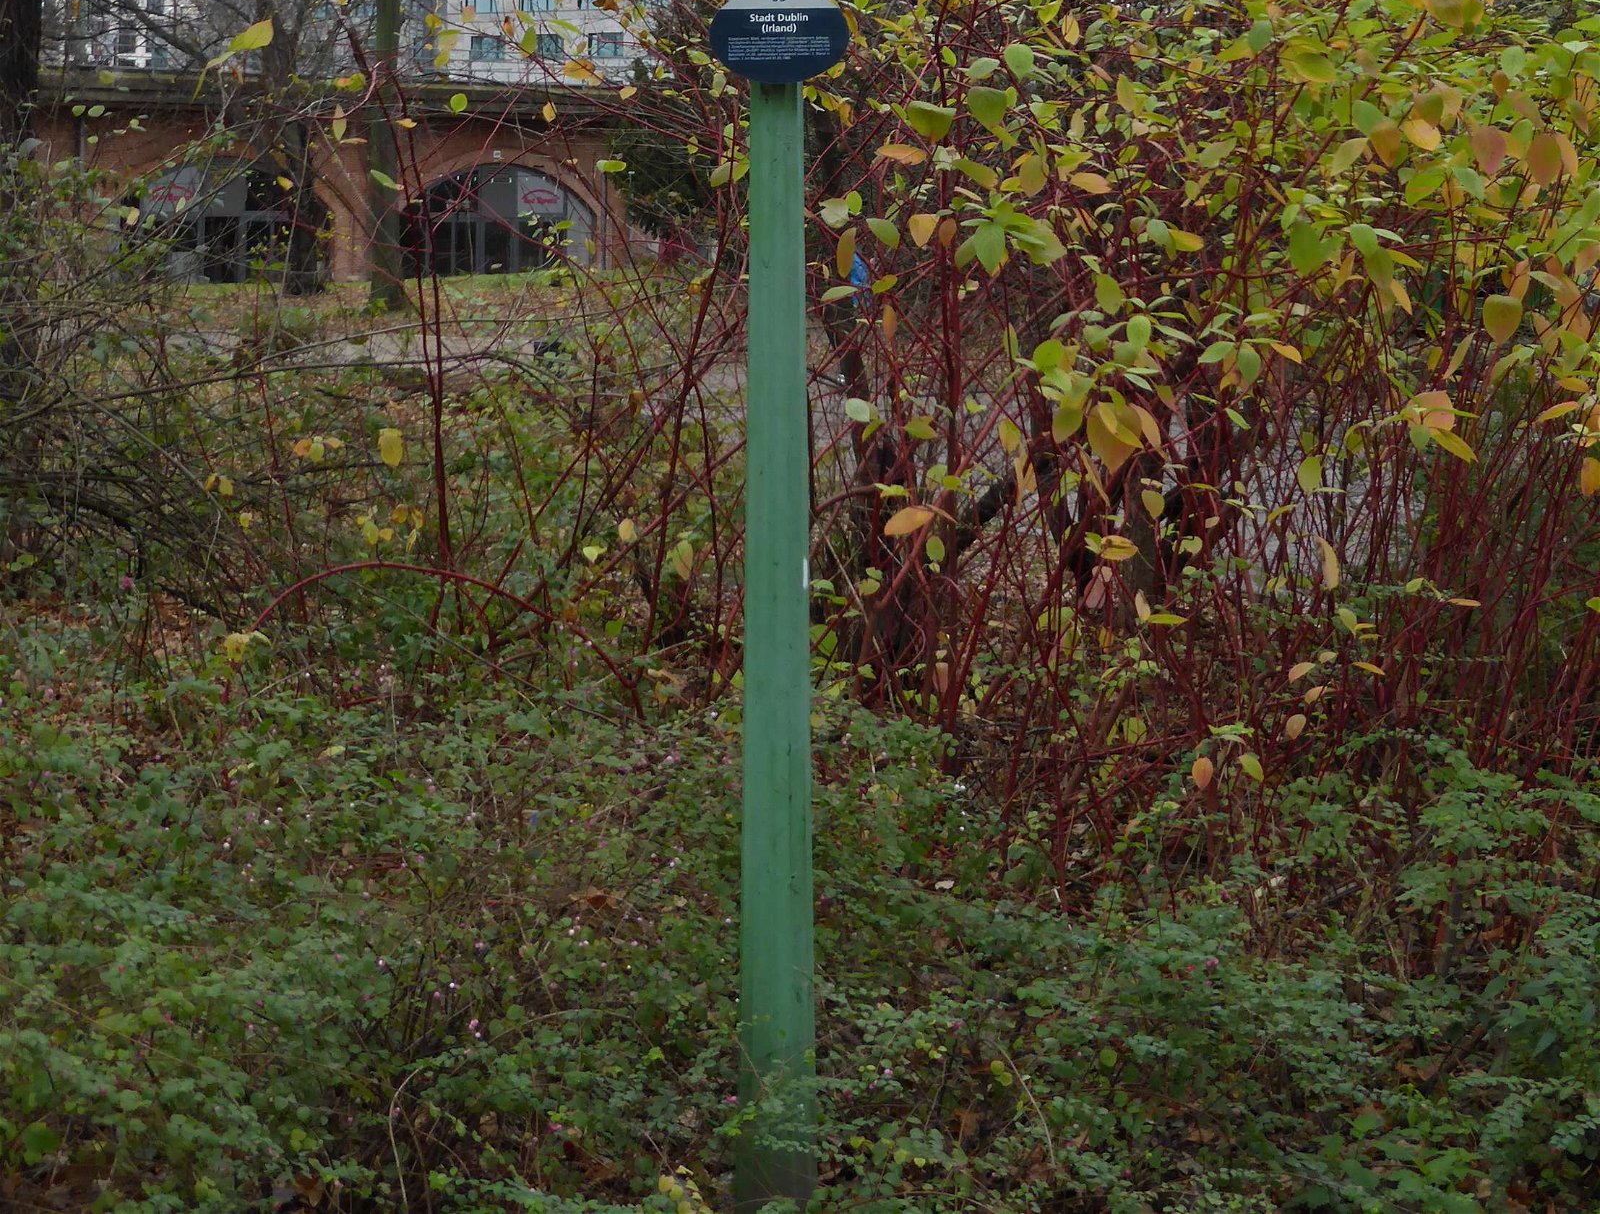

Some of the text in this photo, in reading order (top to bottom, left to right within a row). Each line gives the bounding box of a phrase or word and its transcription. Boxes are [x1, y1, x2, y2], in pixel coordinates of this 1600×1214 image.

[750, 13, 809, 22] Stadt Dublin
[761, 23, 797, 33] (Irland)
